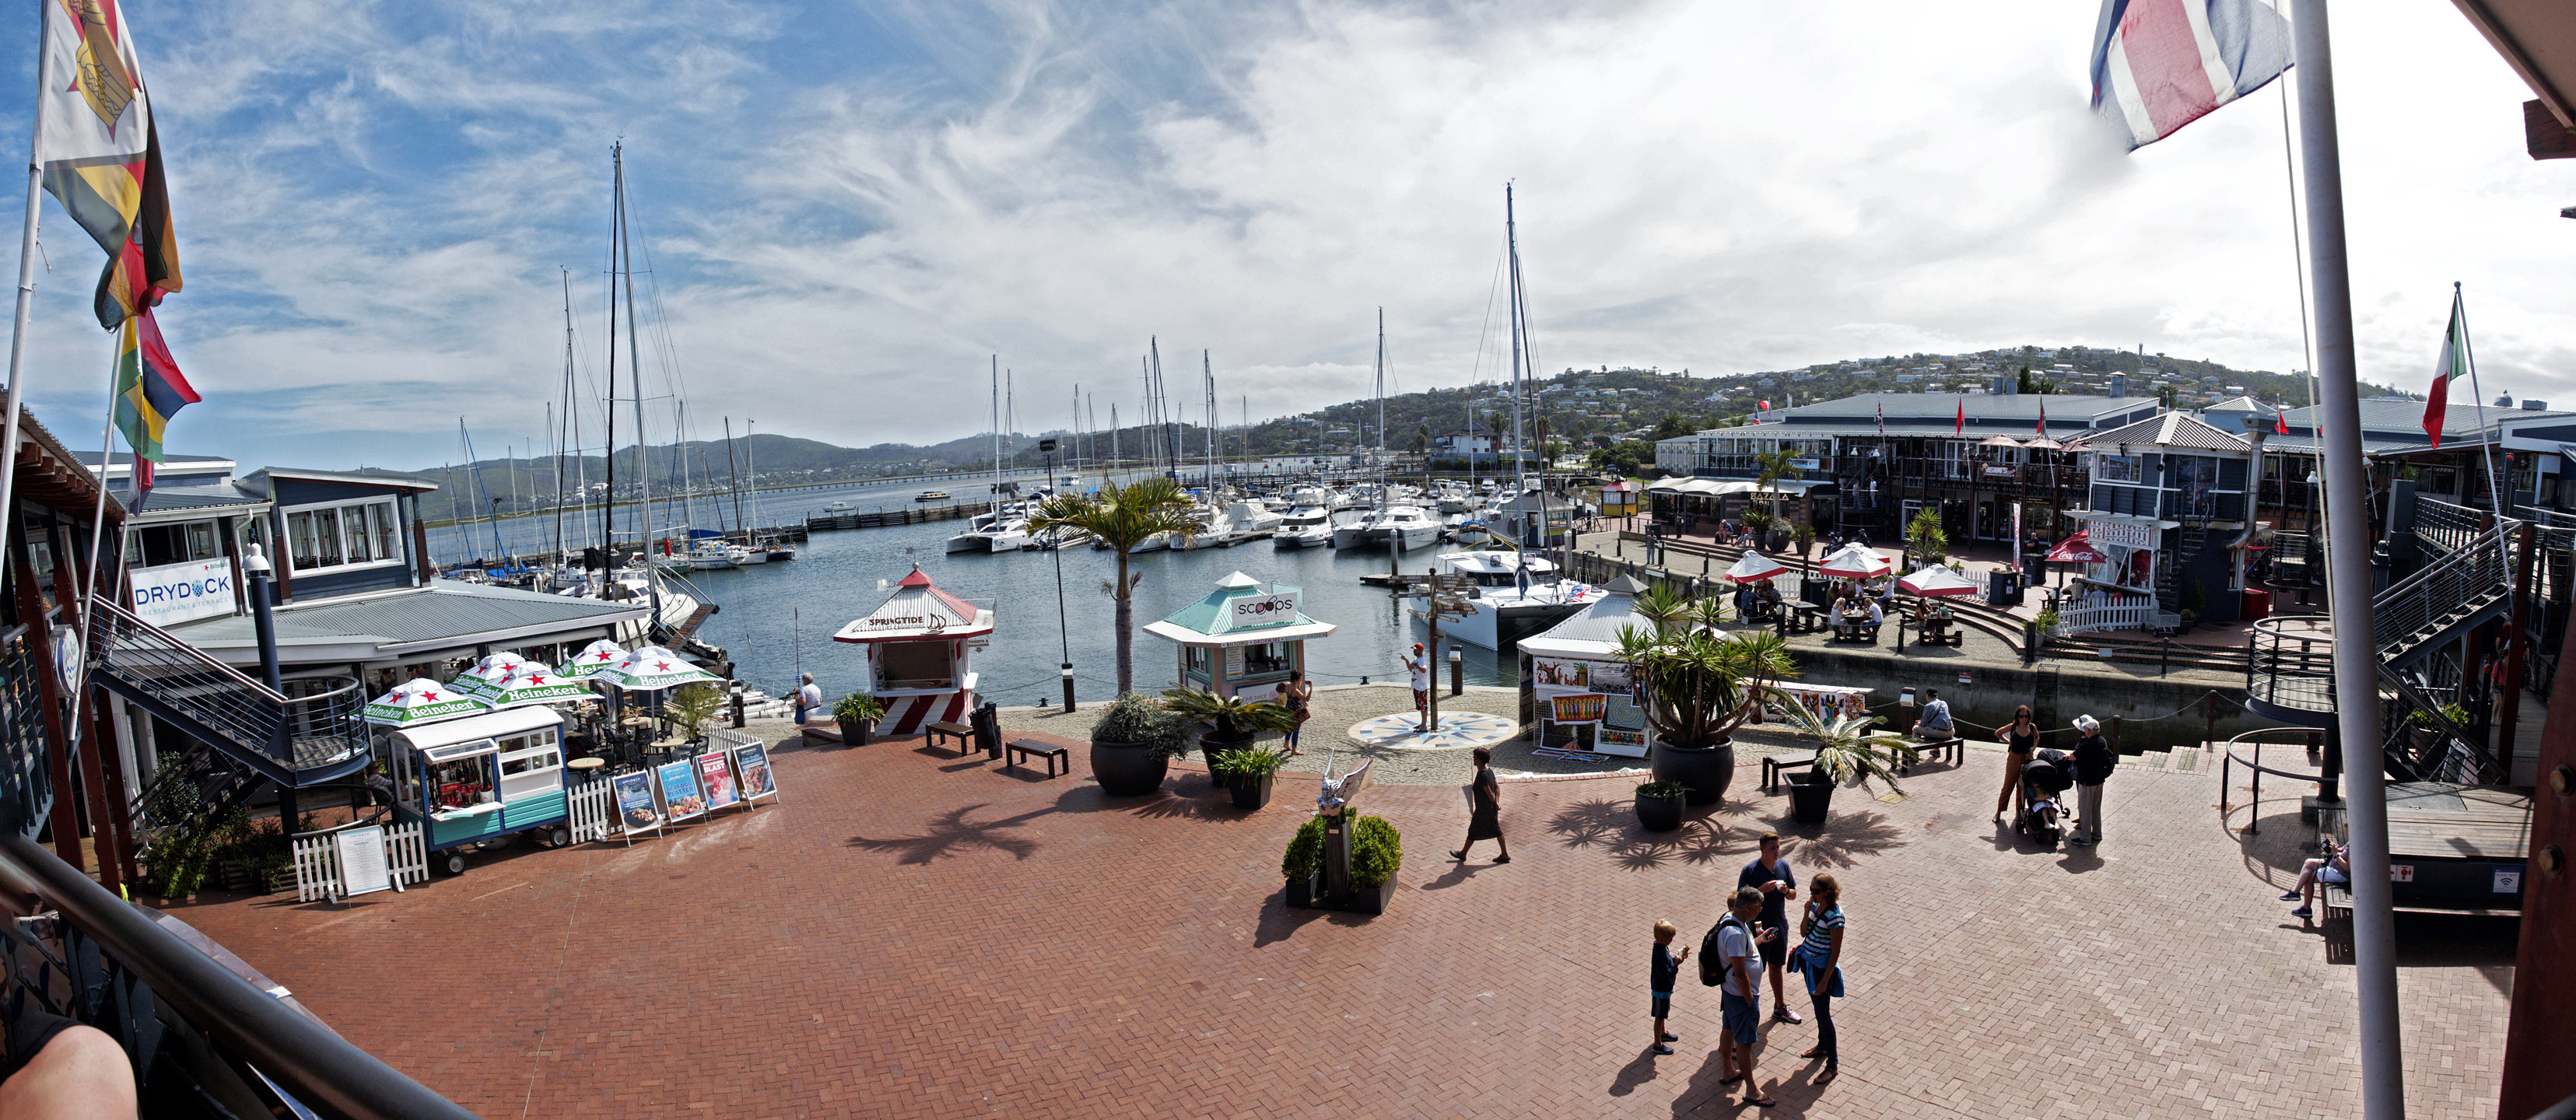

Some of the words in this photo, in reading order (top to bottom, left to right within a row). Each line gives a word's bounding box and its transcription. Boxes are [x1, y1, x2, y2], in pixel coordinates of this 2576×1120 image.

[1751, 492, 1789, 501] BAZAA
[135, 576, 230, 605] DRYDOCK
[143, 604, 190, 616] RESTAURANT
[197, 597, 229, 607] TERRACE
[869, 616, 924, 626] SPRINGTIDE
[639, 671, 701, 686] Heineken
[508, 687, 581, 702] Heineken
[408, 702, 477, 718] Heineken
[703, 763, 725, 773] BLAST
[667, 781, 692, 792] SEAFOOD
[668, 786, 693, 797] PLATTER
